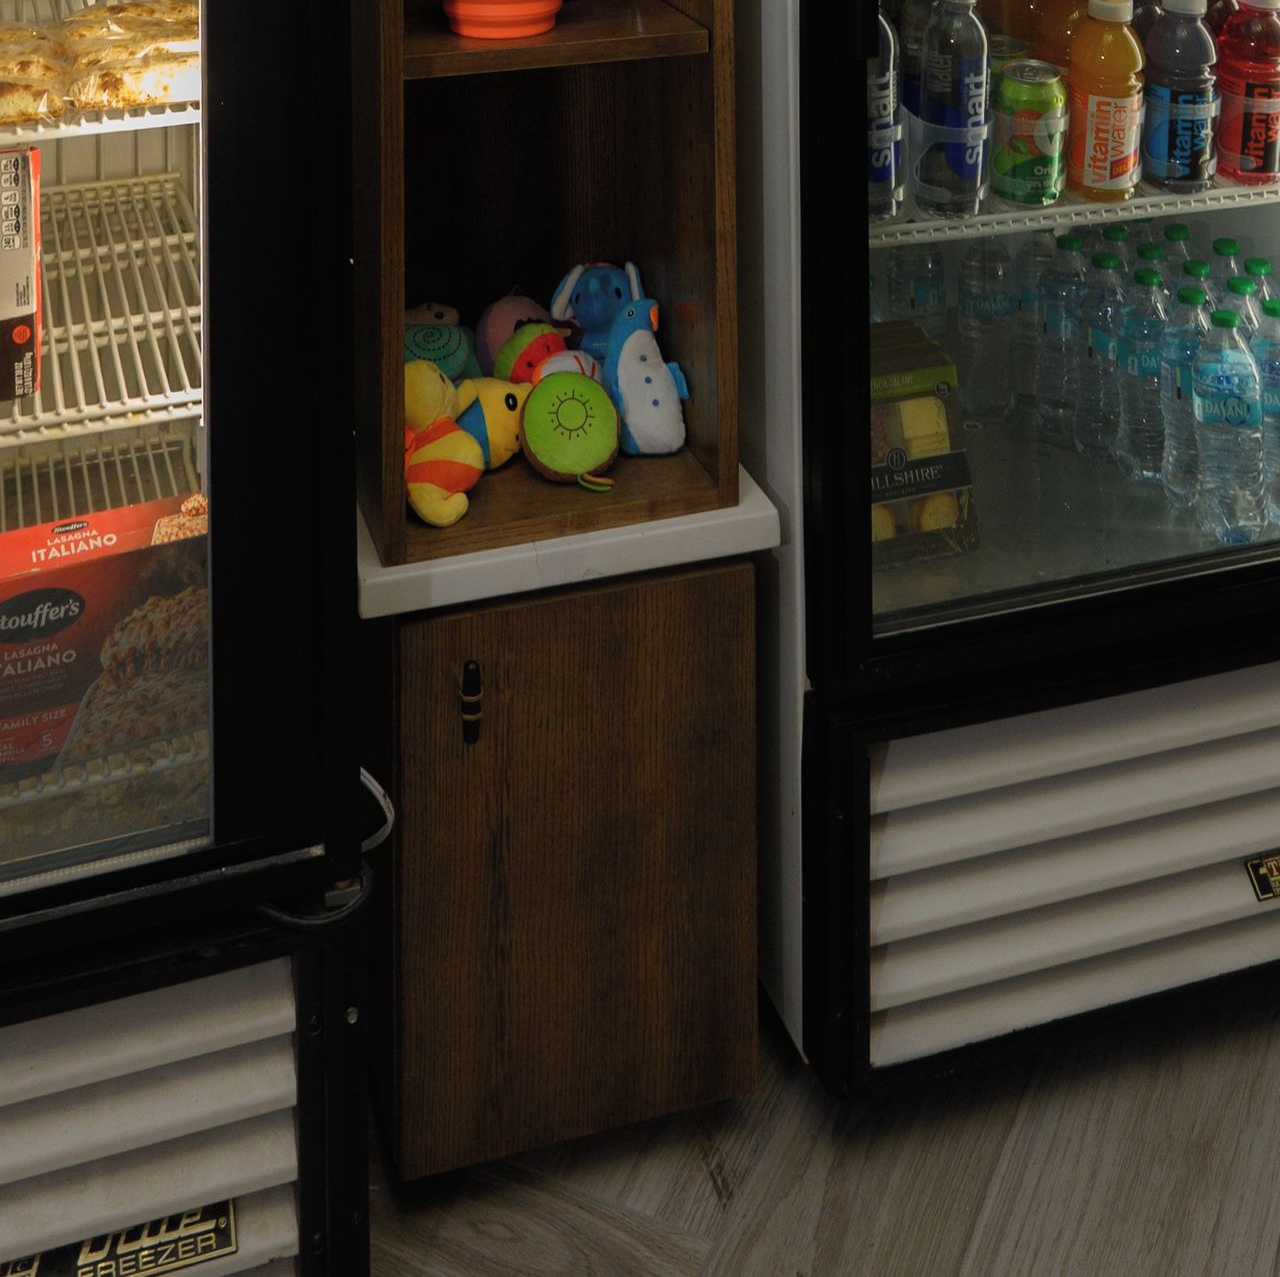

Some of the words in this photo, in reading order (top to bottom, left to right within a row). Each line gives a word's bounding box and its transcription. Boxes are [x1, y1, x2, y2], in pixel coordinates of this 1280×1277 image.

[1109, 100, 1128, 159] water
[1173, 93, 1194, 179] vitamin
[1245, 86, 1267, 168] vitamin
[1089, 99, 1113, 185] vitamin
[1204, 399, 1249, 420] DASANI
[871, 465, 943, 491] ILLSHIRE
[31, 532, 118, 564] ITALIANO
[47, 528, 100, 547] LASAGNA
[4, 641, 59, 662] LASAGNA
[41, 708, 67, 723] SIZE
